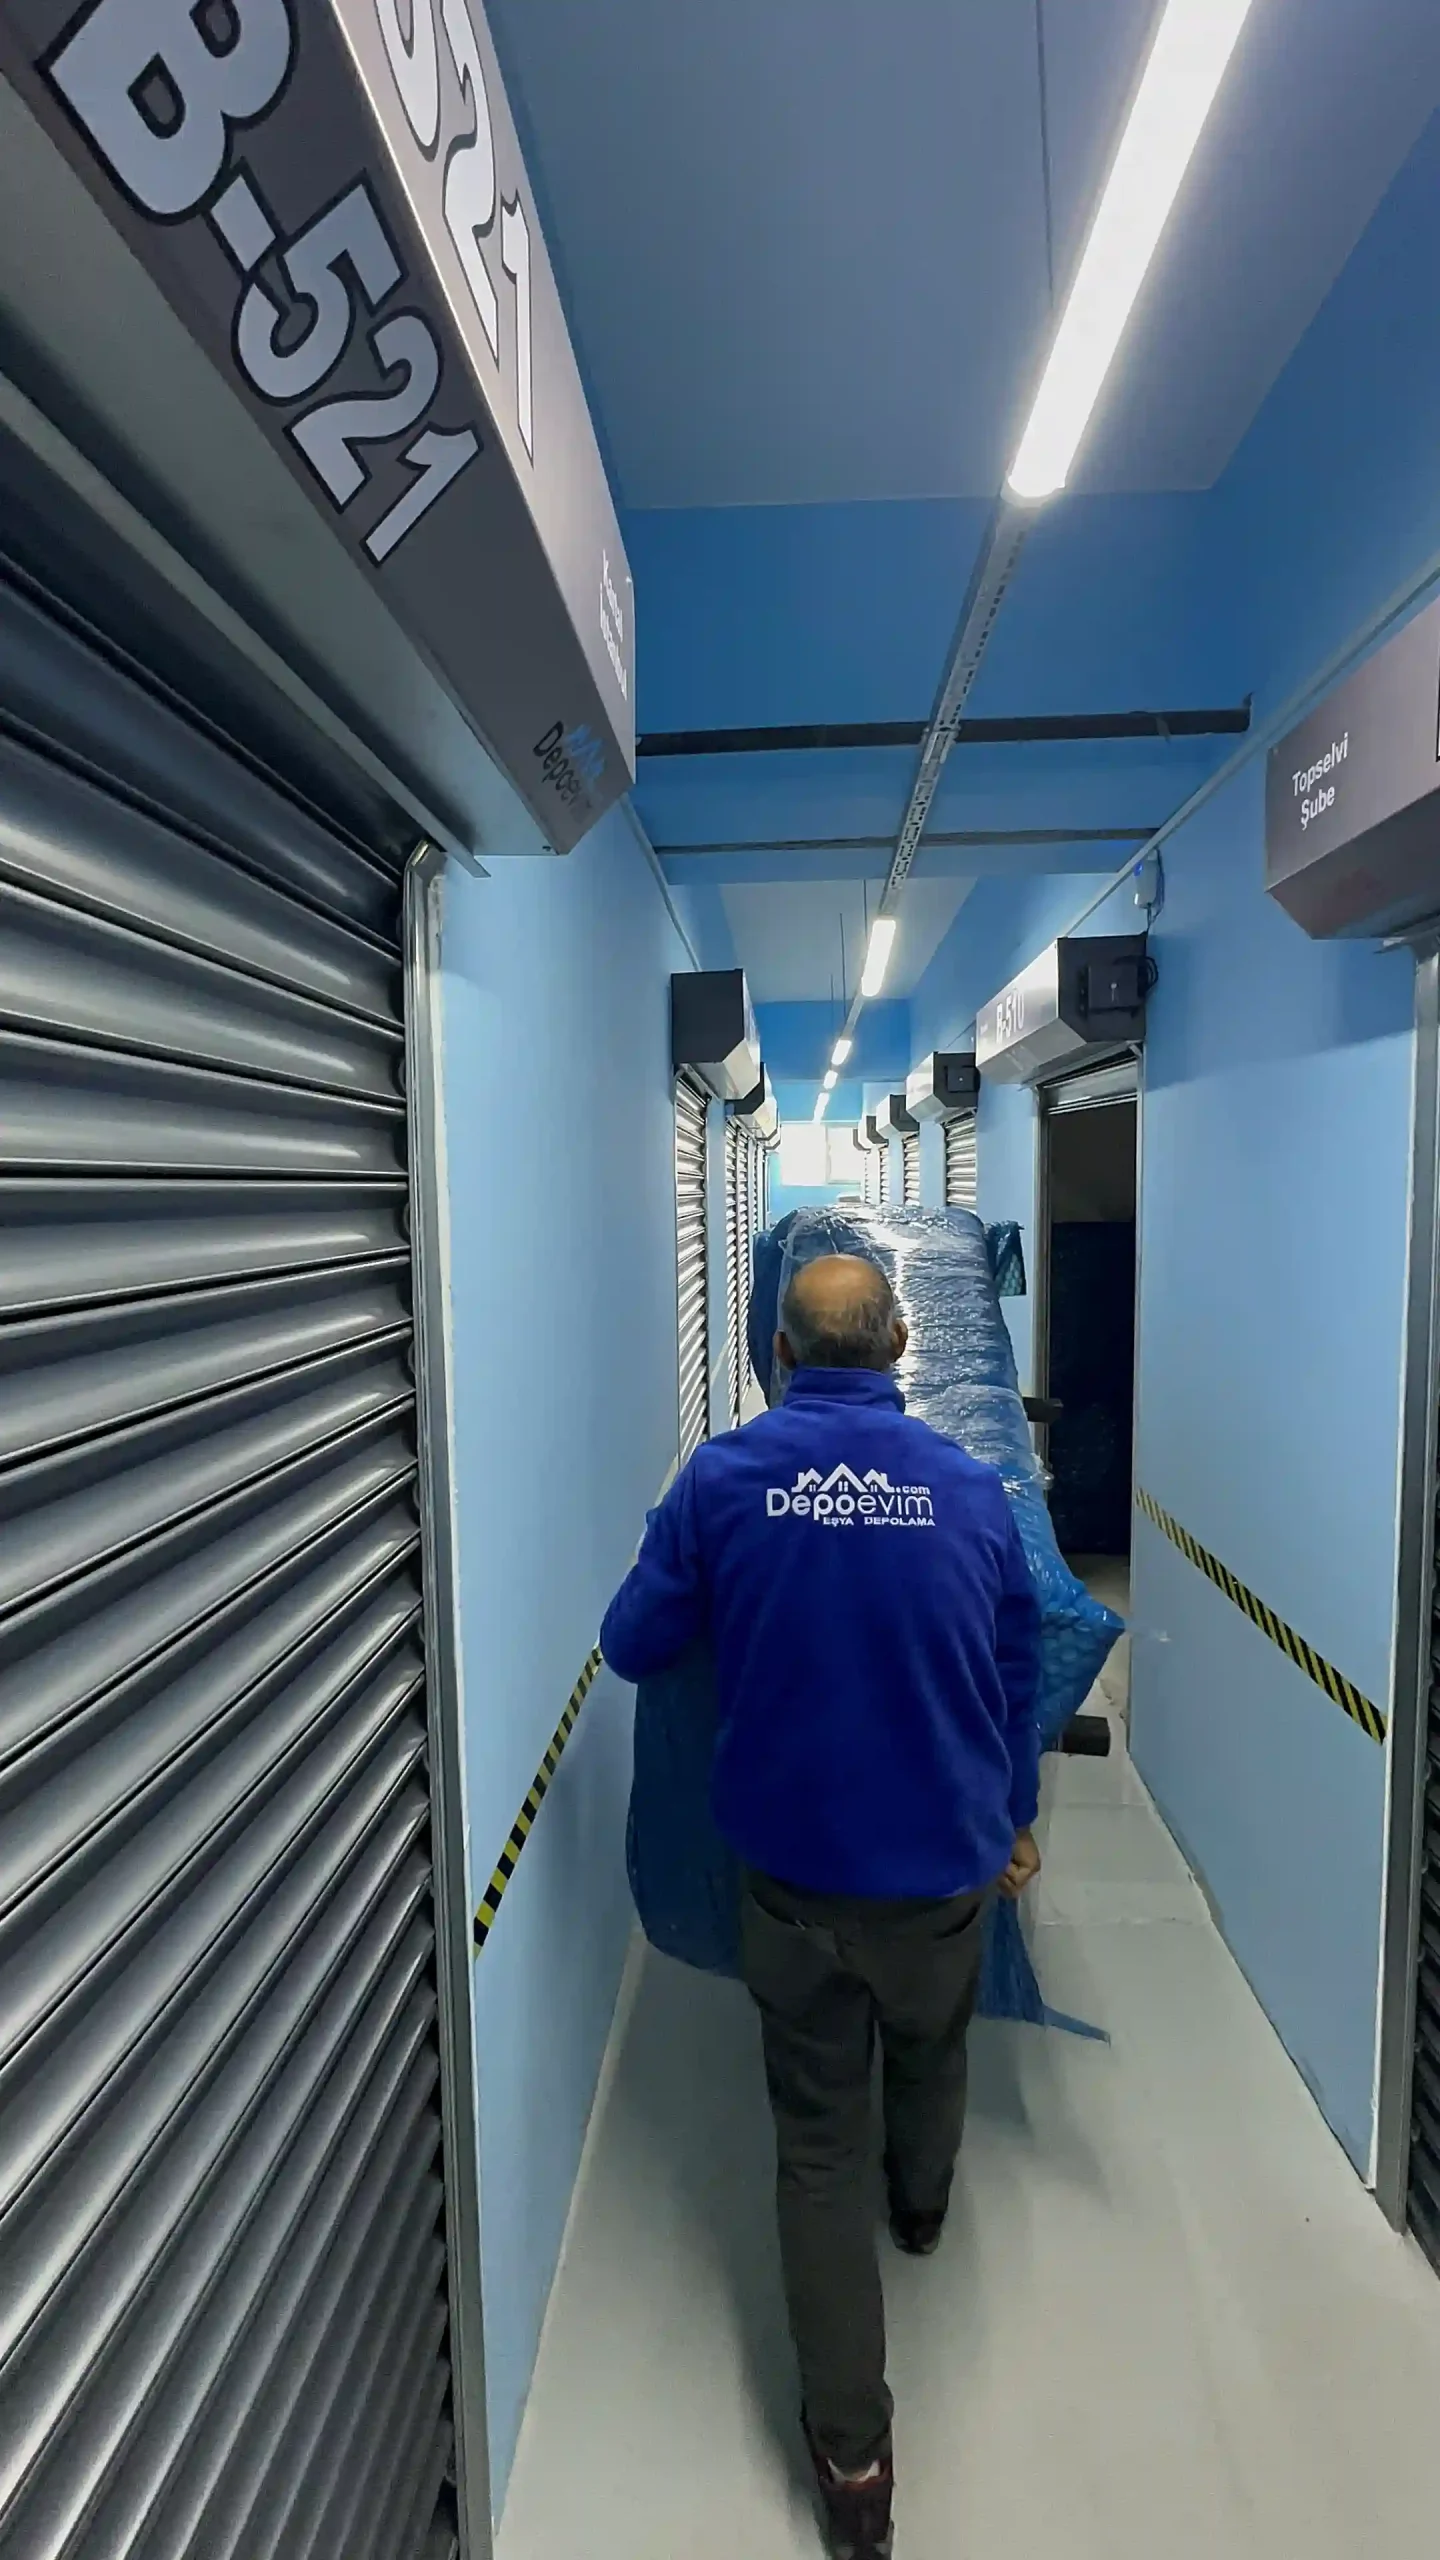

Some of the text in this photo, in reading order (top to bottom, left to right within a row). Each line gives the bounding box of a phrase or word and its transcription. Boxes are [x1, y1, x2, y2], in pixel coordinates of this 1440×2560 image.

[35, 0, 484, 568] B-521
[1292, 732, 1349, 796] Topselvi
[1300, 786, 1335, 831] Şube
[766, 1488, 934, 1521] Depoevim
[895, 1485, 931, 1495] .com
[823, 1517, 936, 1527] EŞYA DEPOLAMA
